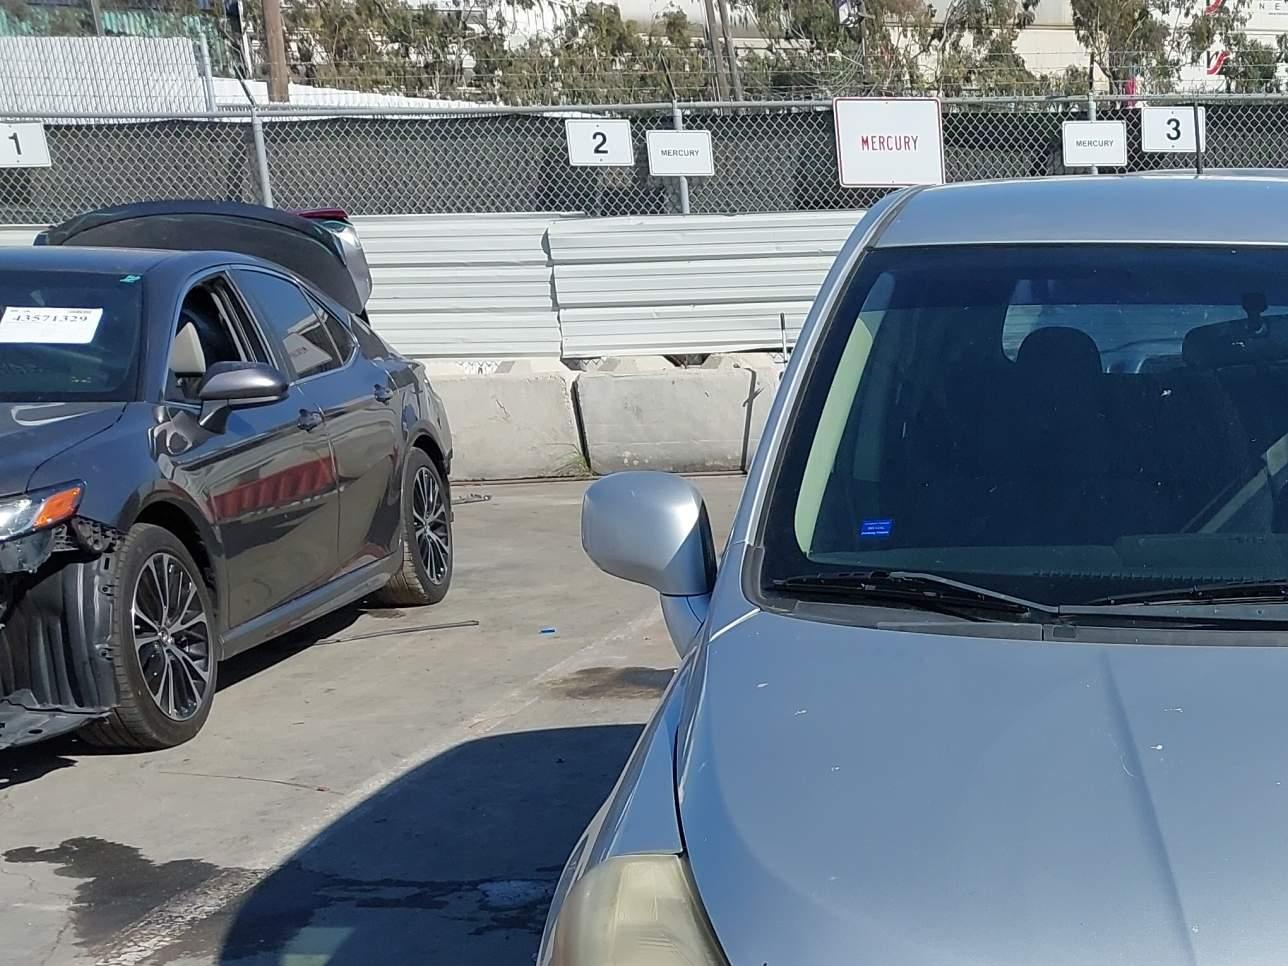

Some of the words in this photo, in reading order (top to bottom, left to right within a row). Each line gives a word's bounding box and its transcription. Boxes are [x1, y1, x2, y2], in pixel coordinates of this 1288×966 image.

[1165, 118, 1181, 141] 3
[8, 132, 21, 155] 1
[592, 131, 609, 154] 2
[861, 135, 919, 151] MERCURY
[1075, 140, 1114, 148] MERCURY
[660, 149, 700, 157] MERCURY
